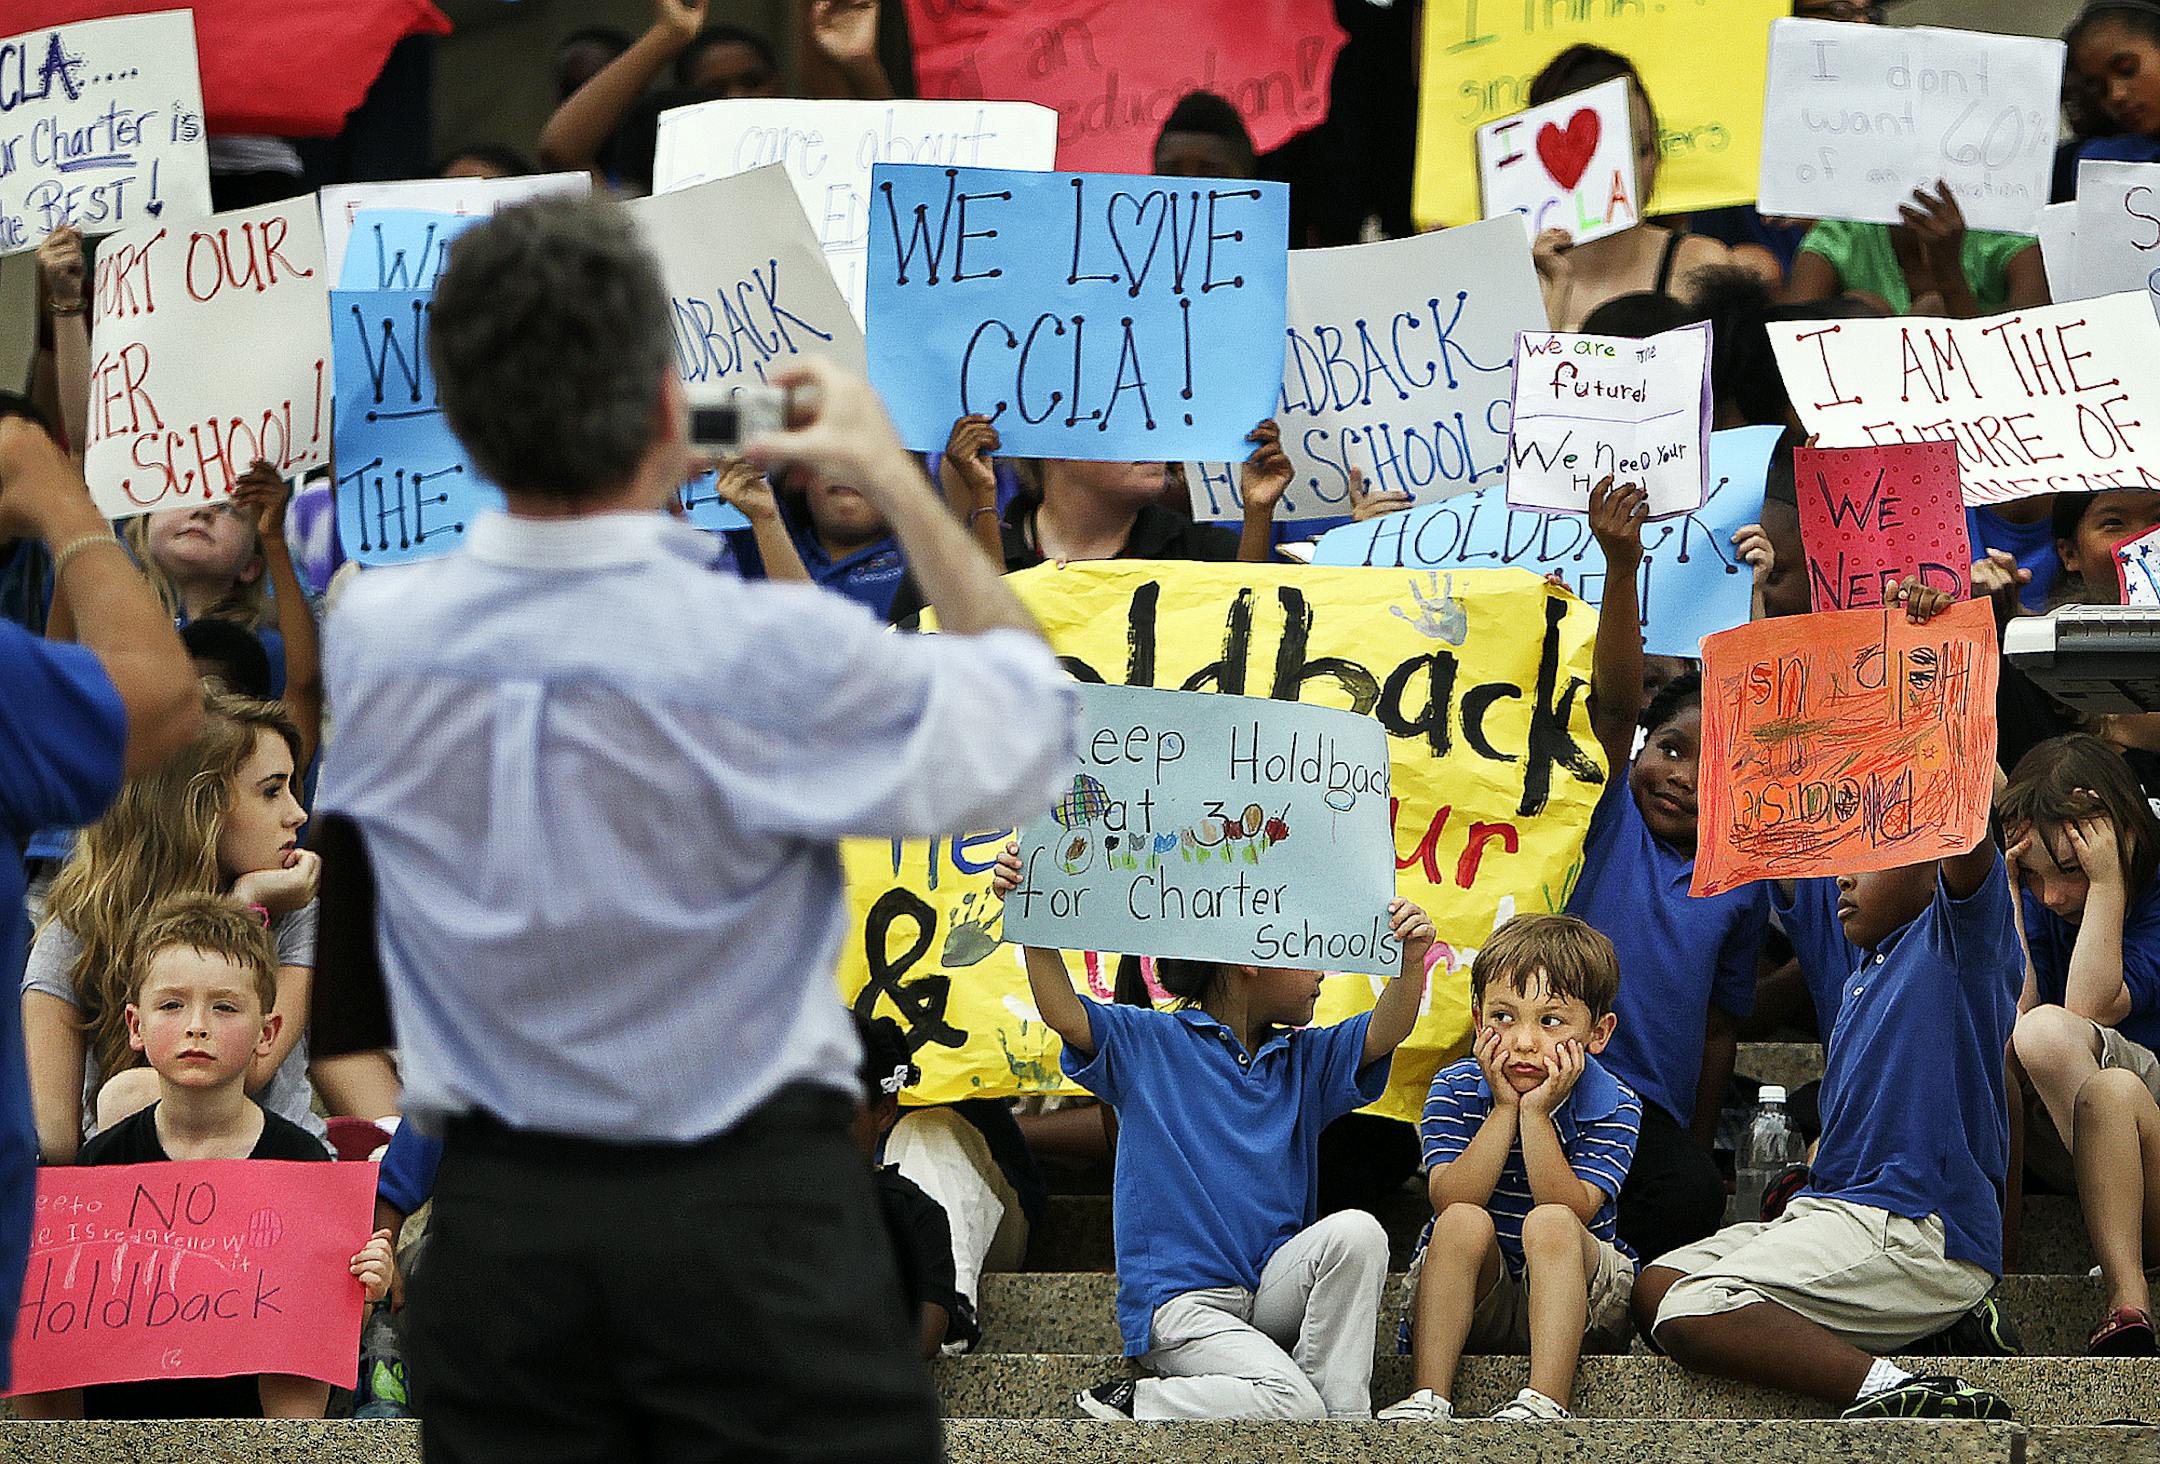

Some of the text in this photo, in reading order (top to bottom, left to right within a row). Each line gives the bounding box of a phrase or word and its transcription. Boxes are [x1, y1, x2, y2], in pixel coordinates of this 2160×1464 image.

[31, 99, 158, 170] Charter
[186, 217, 314, 302] OUR
[880, 169, 1011, 286] WE
[961, 298, 1194, 430] CCLA!
[1523, 335, 1563, 358] We
[1573, 340, 1616, 357] are
[1796, 317, 2120, 410] I AM THE
[123, 357, 325, 506] SCHOOL!
[1512, 430, 1578, 474] We
[2078, 394, 2142, 461] OF
[338, 455, 466, 552] THE
[1815, 467, 1905, 532] WE
[1076, 724, 1186, 785] eep
[1102, 788, 1156, 834] at
[1017, 845, 1091, 919] for
[1128, 869, 1288, 920] Charter
[1251, 915, 1399, 965] Schools
[128, 1181, 218, 1231] NO
